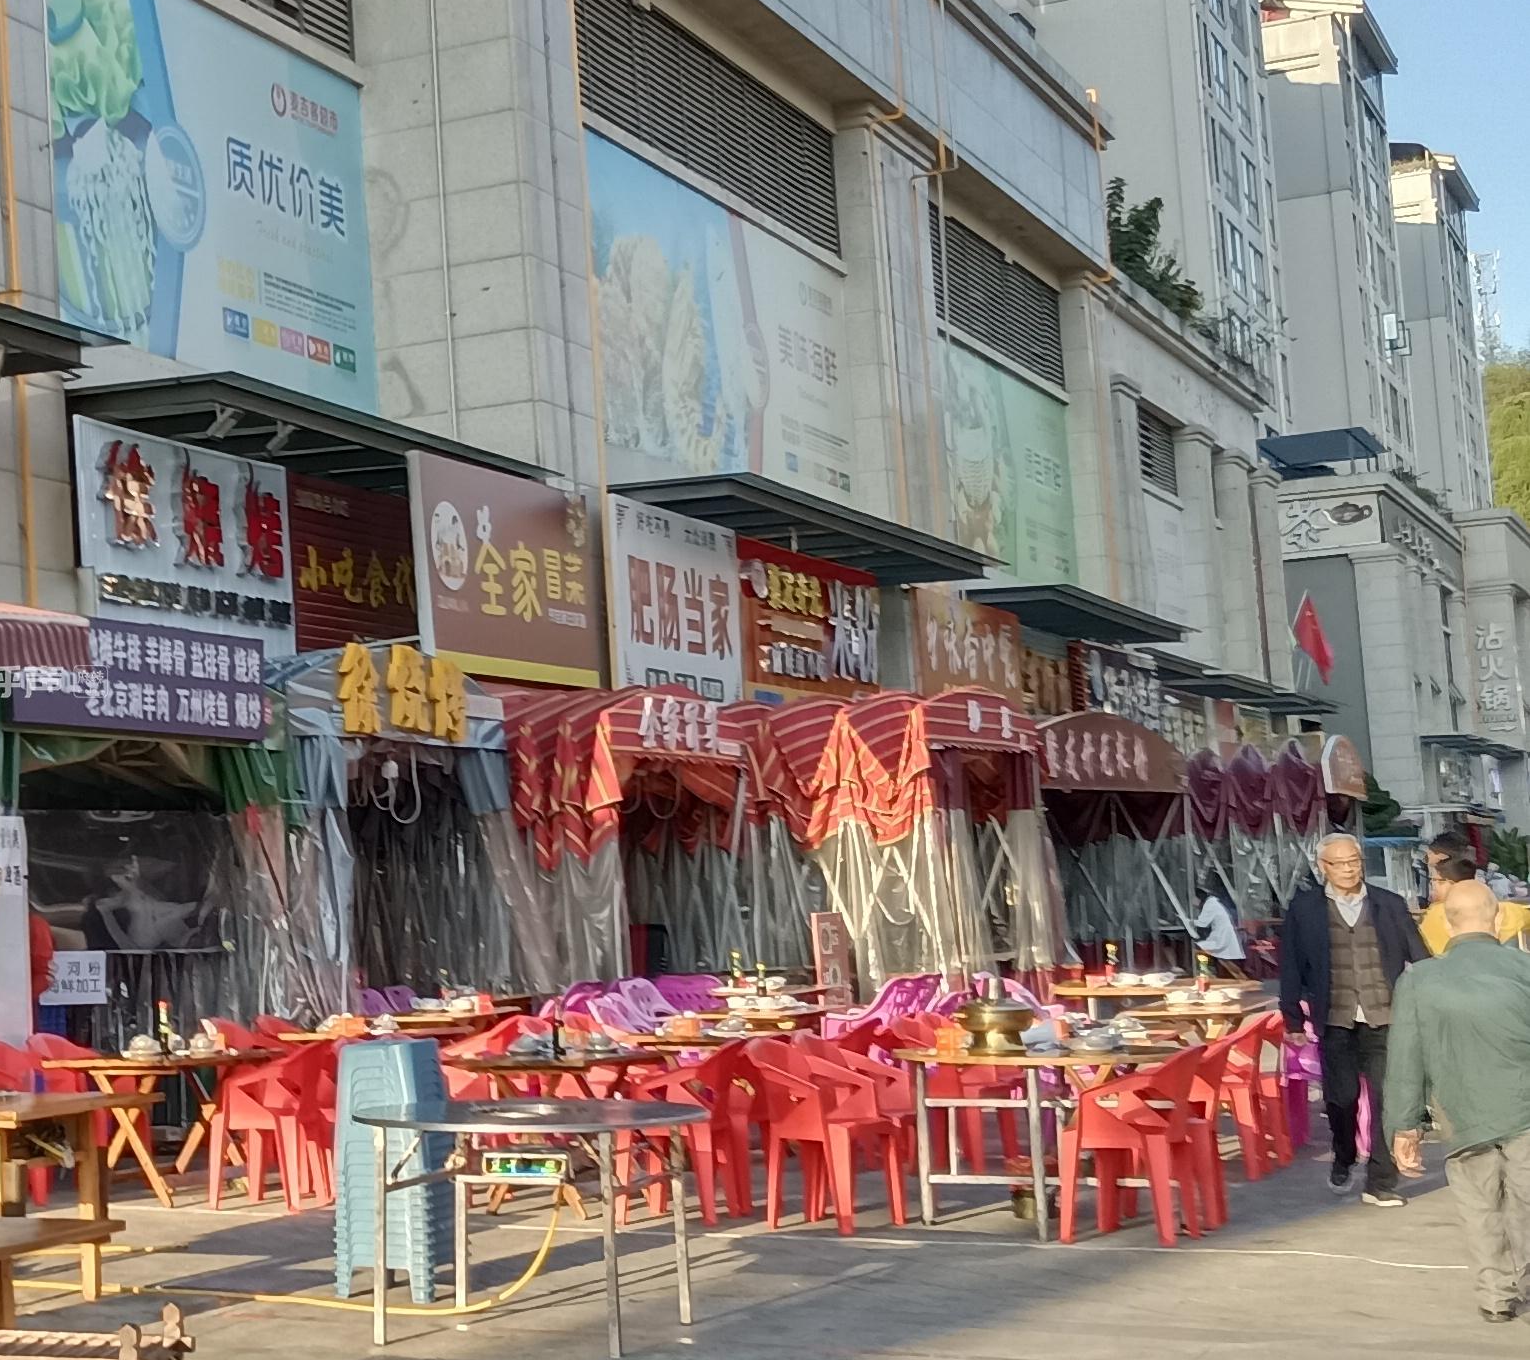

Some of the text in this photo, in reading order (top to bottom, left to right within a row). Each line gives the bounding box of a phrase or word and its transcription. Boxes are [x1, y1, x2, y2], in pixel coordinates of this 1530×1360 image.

[226, 136, 346, 238] 质优价美
[1281, 499, 1330, 551] 茶
[474, 539, 587, 624] 全家冒菜
[627, 554, 734, 661] 肥肠当家
[1475, 622, 1511, 711] 沾火锅
